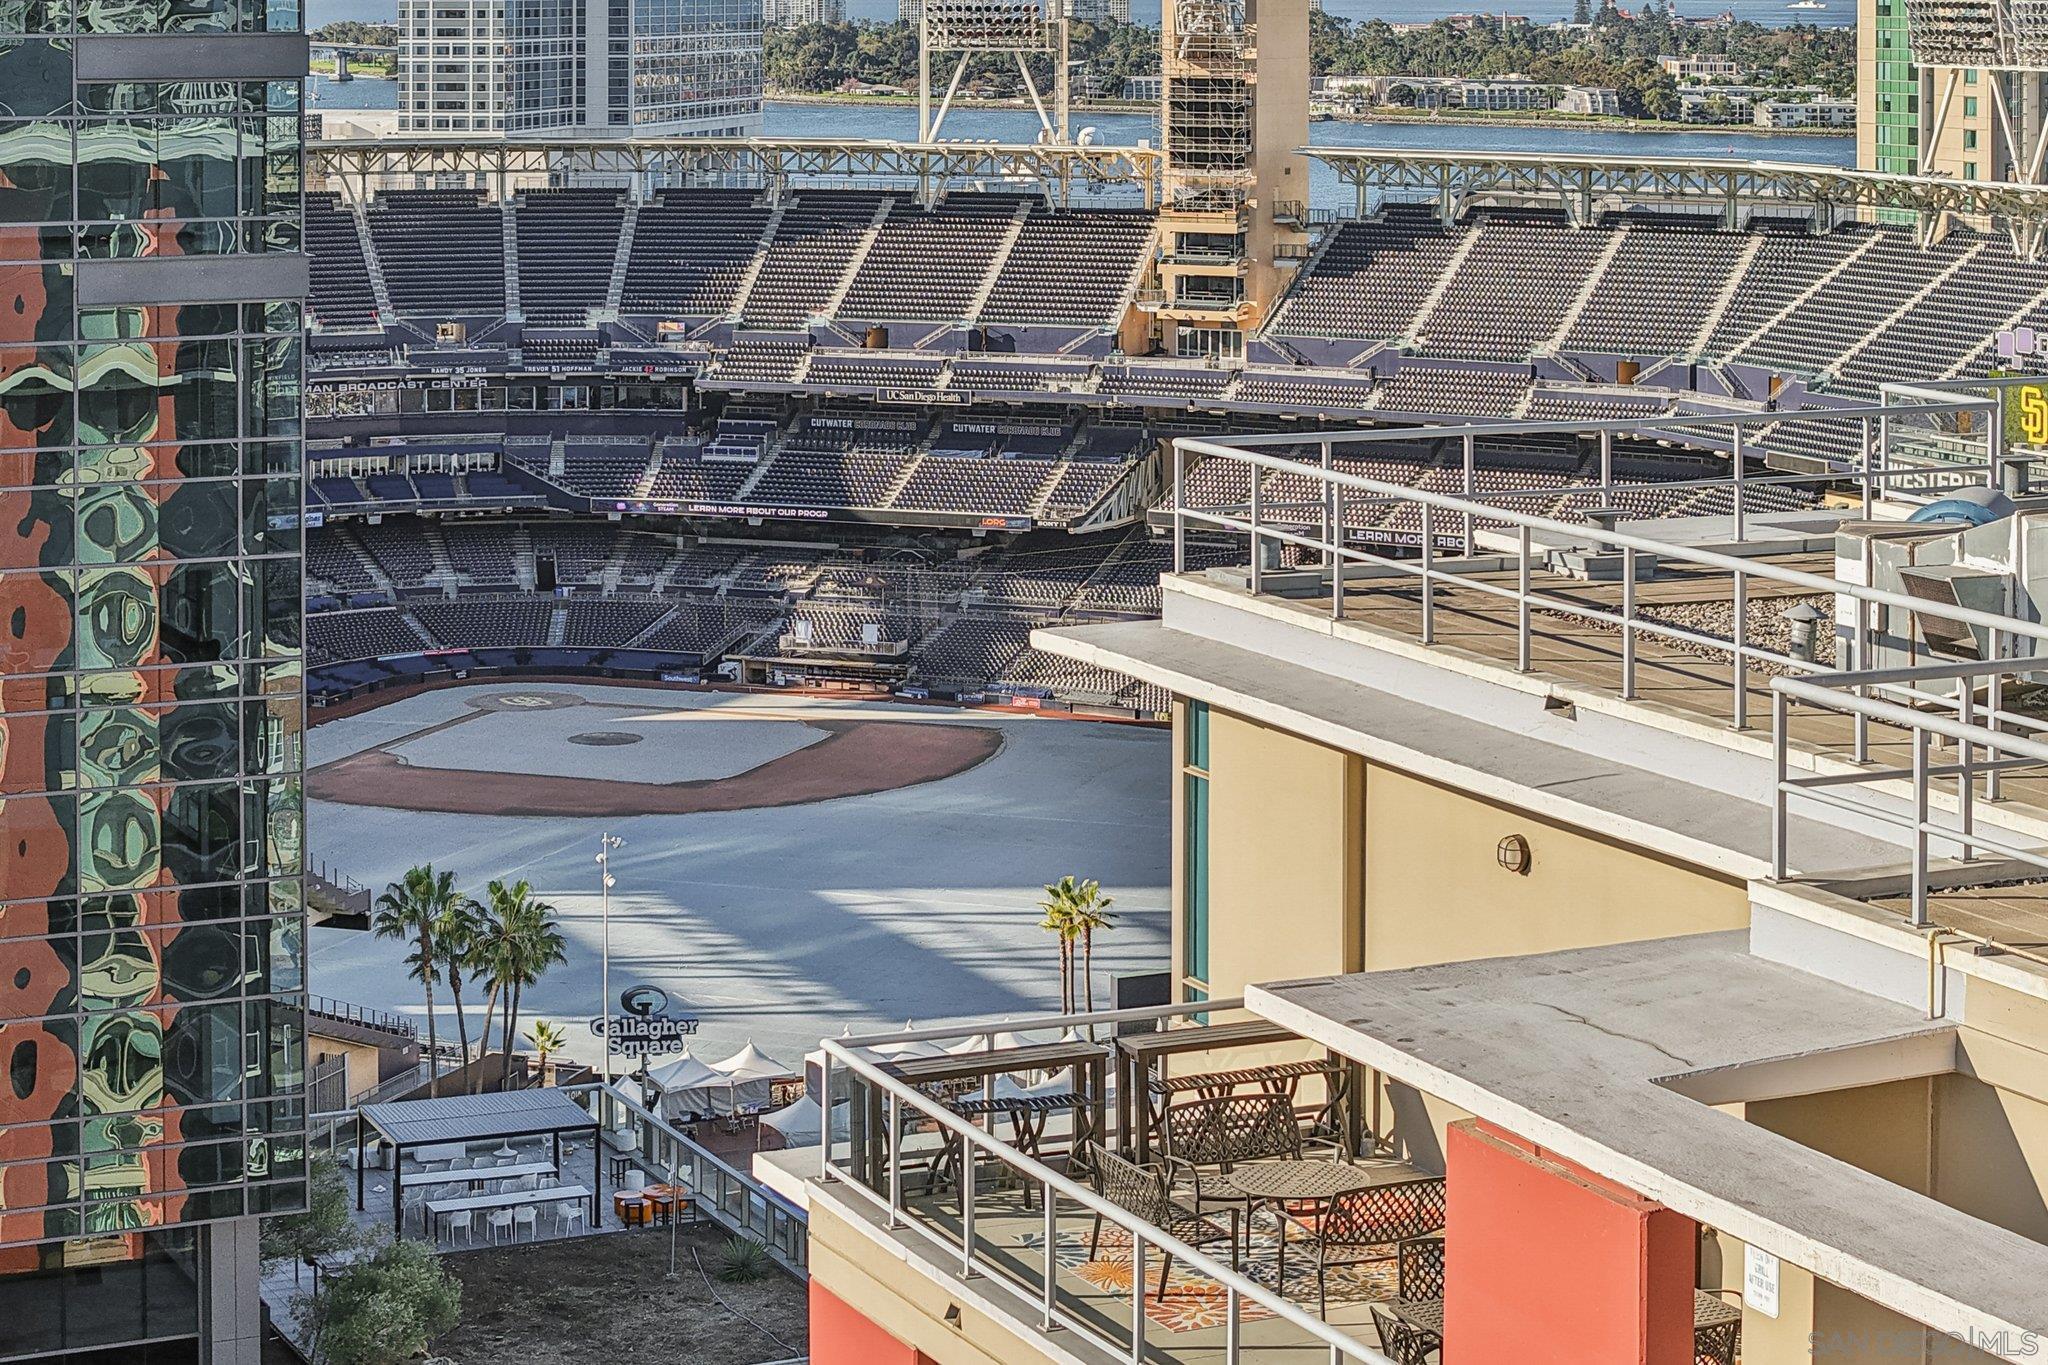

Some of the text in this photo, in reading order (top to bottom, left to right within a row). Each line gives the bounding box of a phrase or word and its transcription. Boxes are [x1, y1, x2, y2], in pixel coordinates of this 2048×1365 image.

[455, 366, 465, 374] 35
[643, 366, 655, 374] 42
[338, 380, 426, 392] BROADCAST
[431, 379, 488, 389] CENTER
[886, 390, 961, 404] UC San Diego Health
[811, 418, 853, 428] CUTWATER
[953, 423, 996, 434] CUTWATER
[1888, 461, 1976, 489] WESTERN
[688, 504, 828, 518] LEARN MORE ABOUT OUR PROGR
[1349, 529, 1393, 543] LEARN
[1394, 534, 1434, 546] MOR
[663, 674, 694, 683] Southwest
[591, 1016, 699, 1040] Gallagher
[608, 1037, 683, 1059] Square
